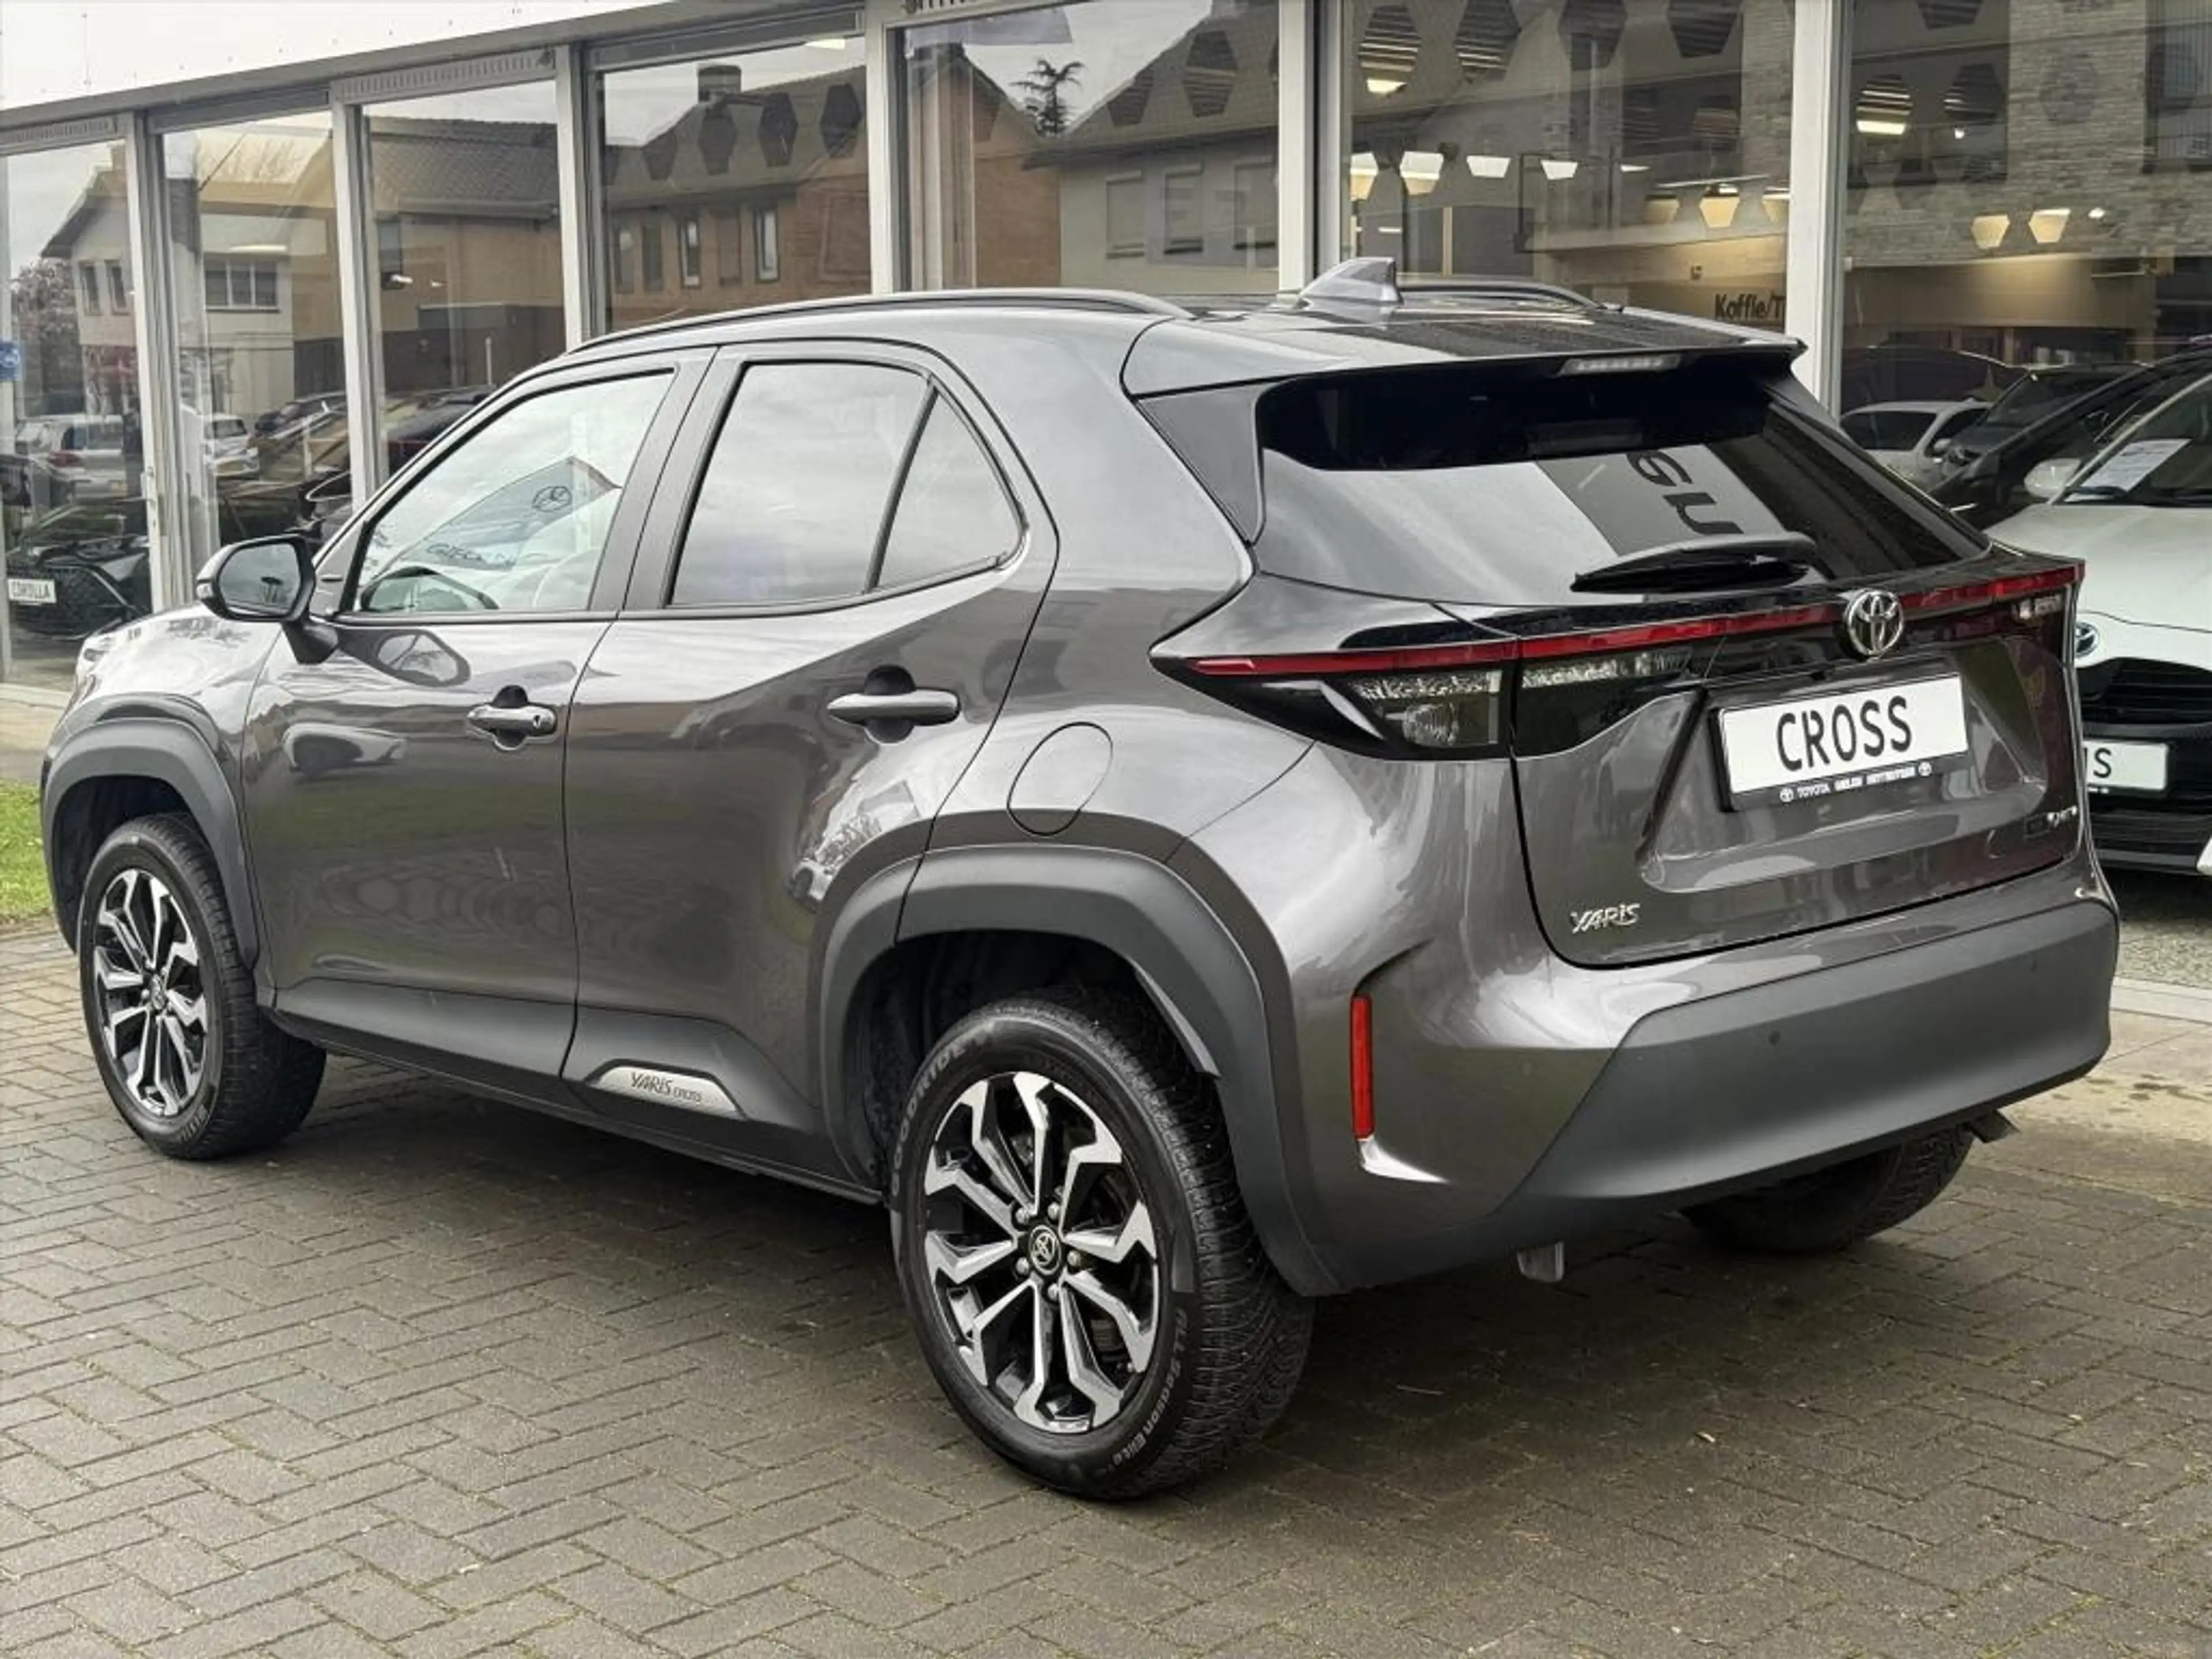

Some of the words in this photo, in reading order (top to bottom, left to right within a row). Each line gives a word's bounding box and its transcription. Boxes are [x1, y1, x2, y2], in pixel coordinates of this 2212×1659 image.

[1777, 695, 1912, 772] CROSS
[1570, 903, 1641, 935] YARIS
[631, 1071, 673, 1095] YARIS
